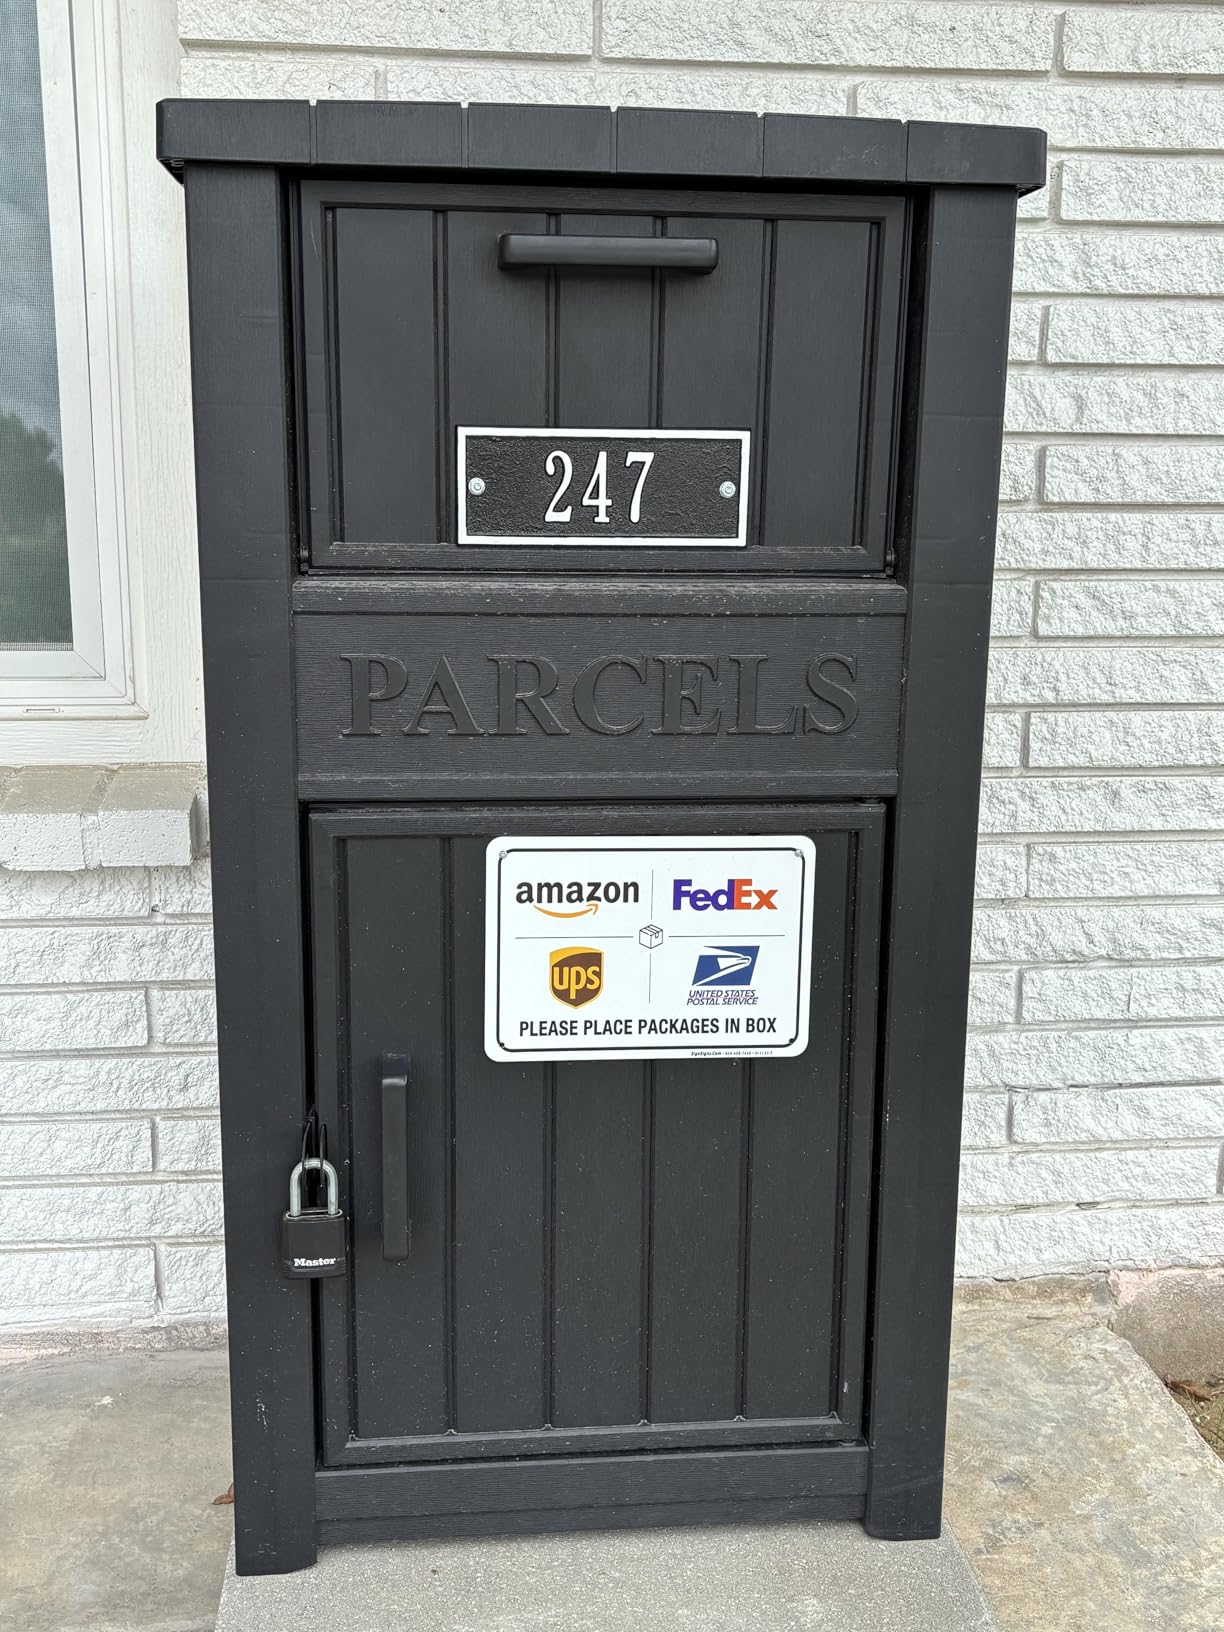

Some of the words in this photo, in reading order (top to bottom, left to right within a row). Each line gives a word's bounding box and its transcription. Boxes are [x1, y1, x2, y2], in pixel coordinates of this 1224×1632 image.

[544, 450, 654, 523] 247
[340, 652, 858, 736] PARCELS
[515, 881, 640, 903] amazon
[672, 878, 778, 912] FedEx
[553, 966, 600, 999] ups
[689, 989, 723, 998] UNITED
[724, 989, 756, 998] STATES
[687, 997, 720, 1006] POSTAL
[722, 997, 759, 1005] SERVICE
[519, 1020, 578, 1037] PLEASE
[583, 1019, 633, 1036] PLACE
[638, 1018, 720, 1035] PACKAGES
[725, 1017, 741, 1034] IN
[746, 1017, 777, 1034] BOX
[293, 1257, 336, 1267] Master
